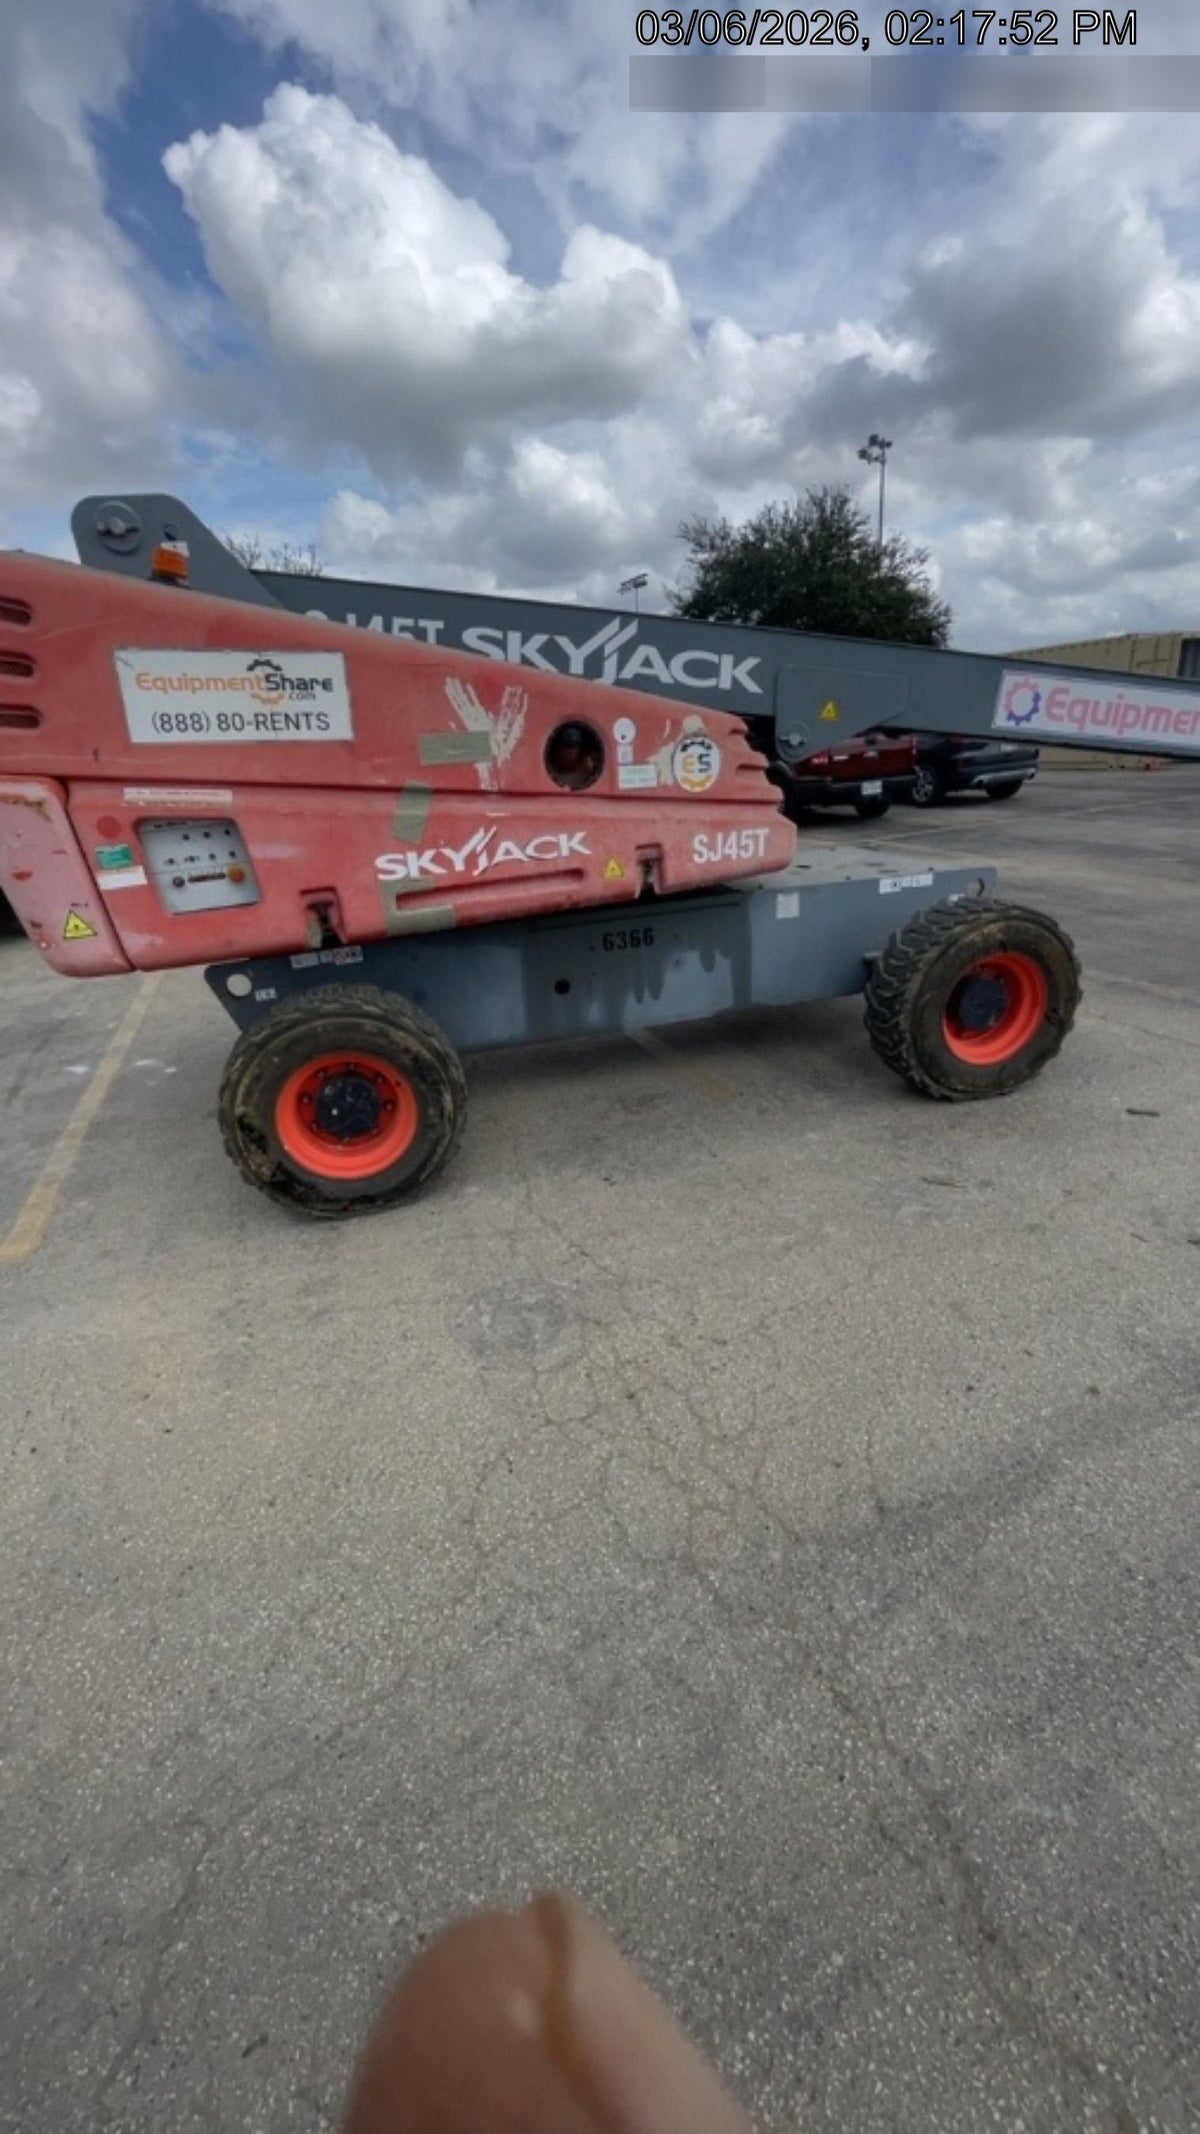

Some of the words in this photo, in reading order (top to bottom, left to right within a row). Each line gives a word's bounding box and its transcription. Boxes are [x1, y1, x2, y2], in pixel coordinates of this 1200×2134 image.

[461, 616, 764, 694] SKYJACK
[135, 672, 334, 694] EquipmentShare
[151, 711, 211, 733] (888)
[216, 711, 331, 733] 80-RENTS
[374, 825, 593, 881] SKYJACK
[692, 827, 770, 864] SJ45T
[602, 926, 655, 952] 6366
